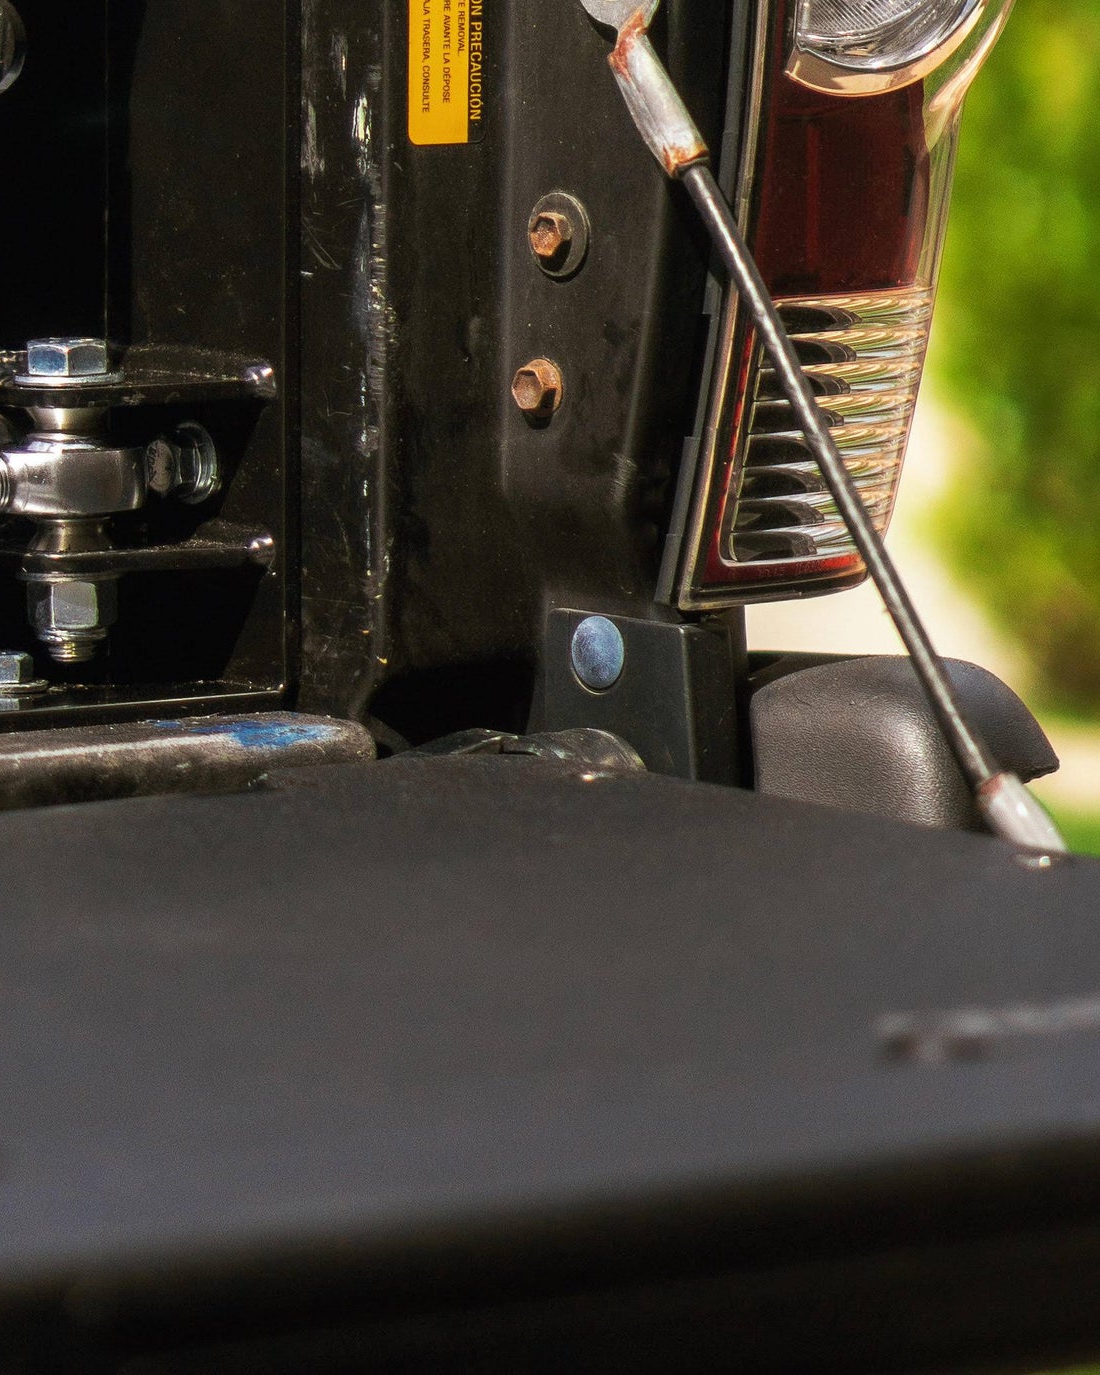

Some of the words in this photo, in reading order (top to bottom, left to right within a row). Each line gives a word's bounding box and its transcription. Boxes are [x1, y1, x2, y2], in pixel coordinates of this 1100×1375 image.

[442, 14, 450, 49] AVANTE
[442, 52, 450, 64] LA
[470, 22, 484, 120] PRECAUCIÓN
[422, 65, 430, 113] CONSULTE
[442, 67, 452, 104] DÉPOSE
